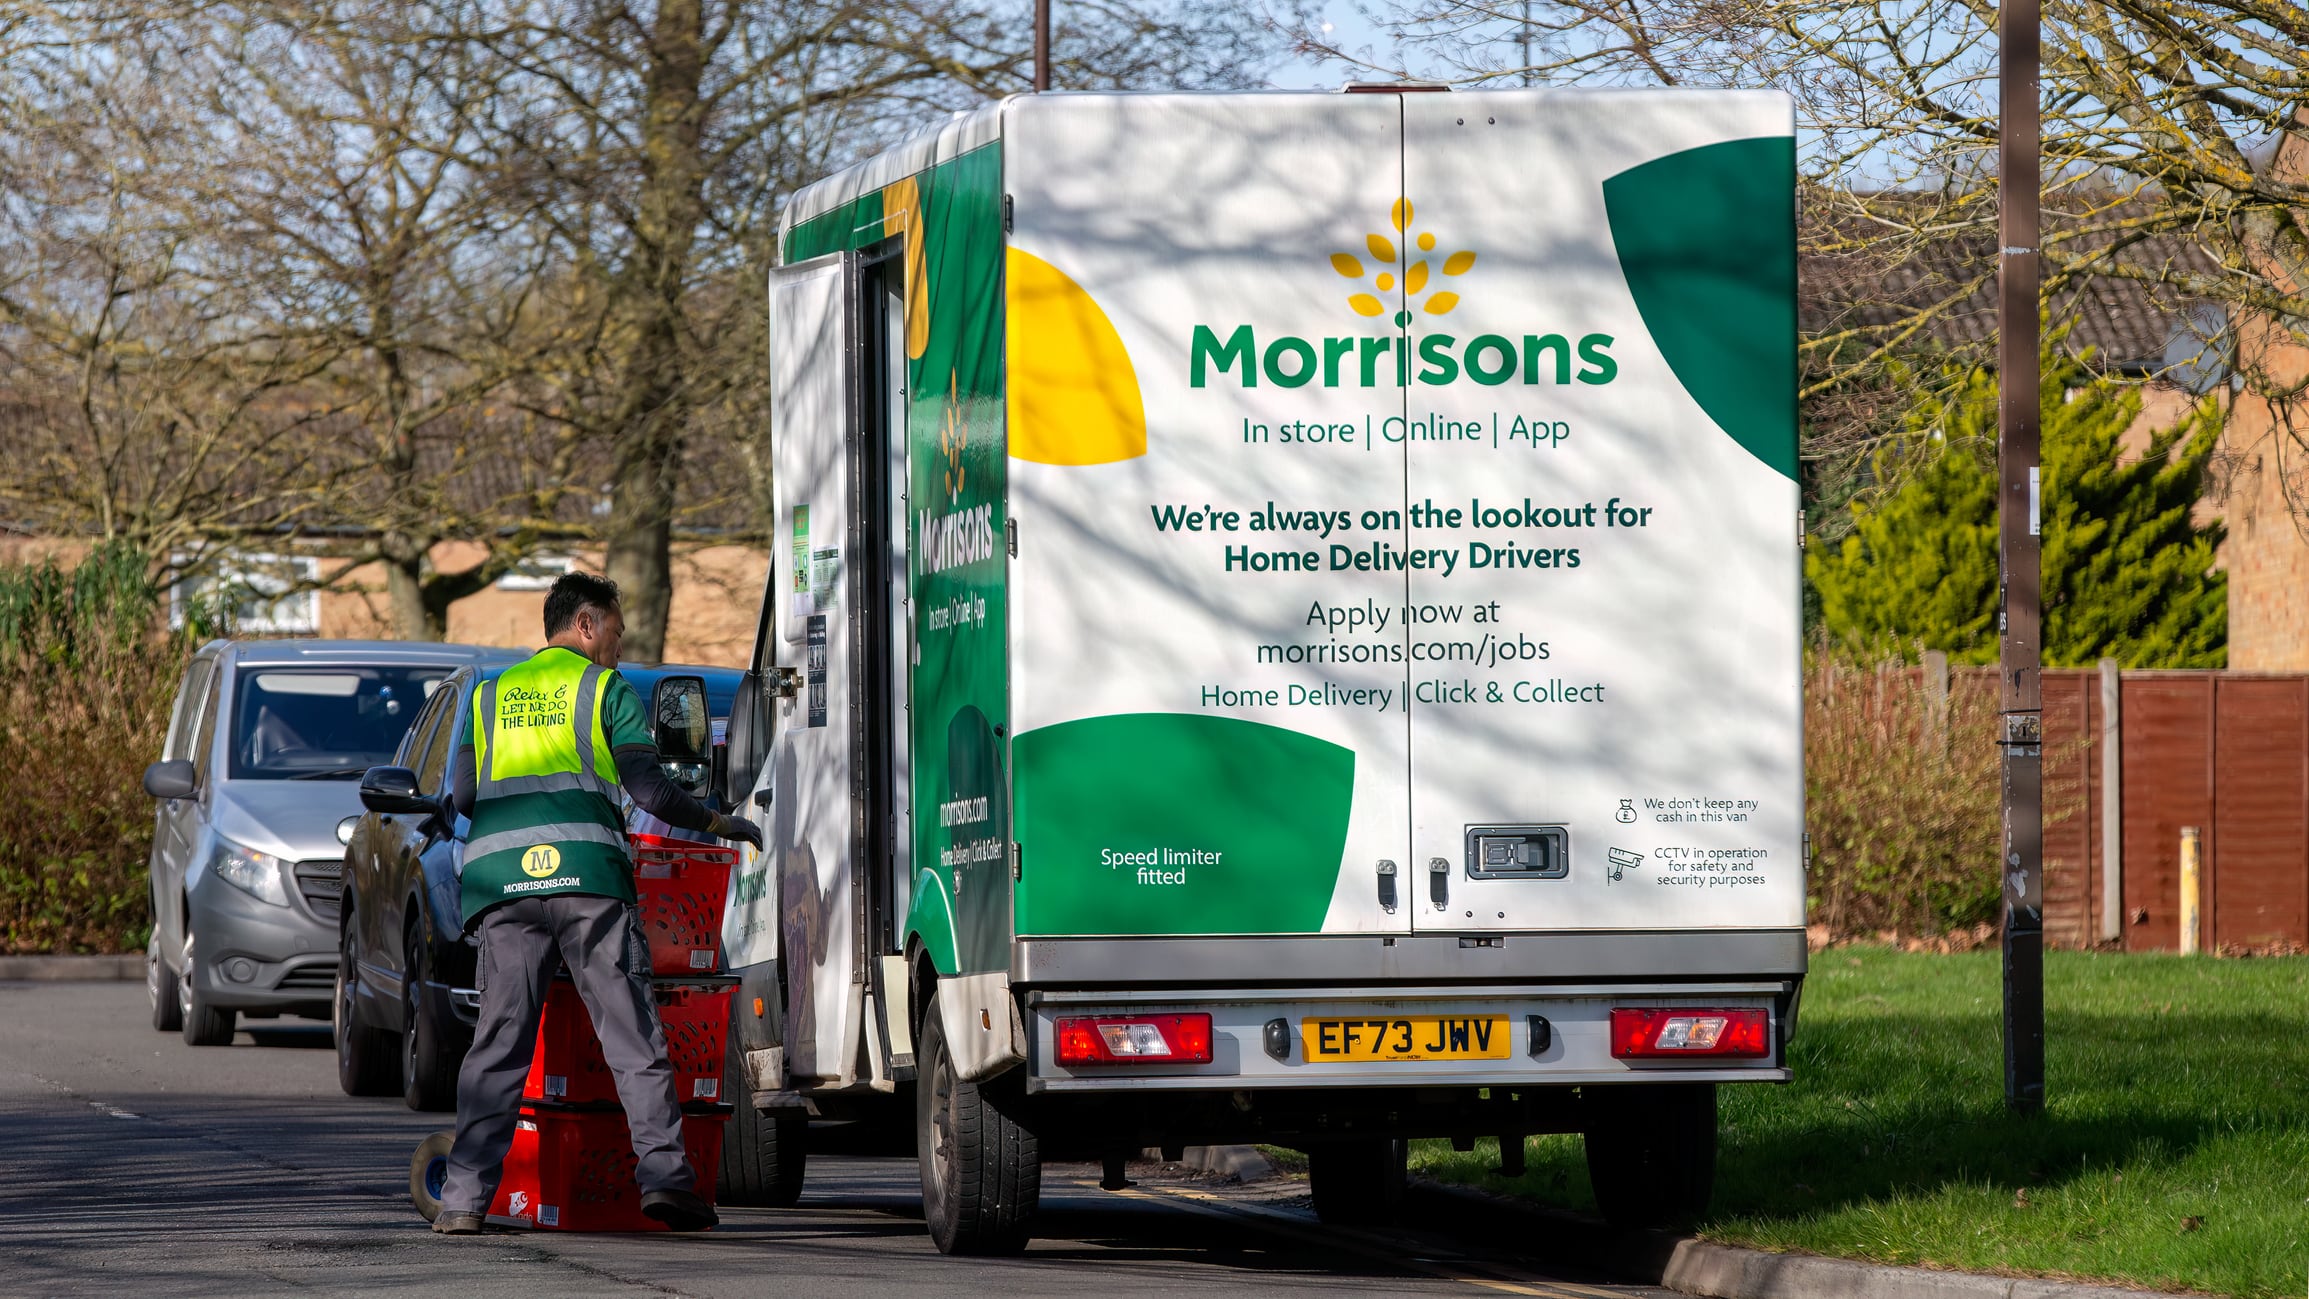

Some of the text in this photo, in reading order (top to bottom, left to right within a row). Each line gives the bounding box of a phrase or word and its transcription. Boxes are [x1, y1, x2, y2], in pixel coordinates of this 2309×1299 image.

[1190, 310, 1618, 388] Morrisons
[1243, 418, 1268, 443] In
[1280, 420, 1355, 443] store
[1382, 413, 1481, 443] Online
[1509, 415, 1570, 448] App
[919, 487, 993, 576] Morrisons
[1151, 498, 1653, 539] We're always on the lookout for
[1225, 541, 1581, 578] Home Delivery Drivers
[928, 604, 935, 631] In
[935, 604, 949, 631] store
[952, 593, 971, 627] Online
[973, 592, 985, 628] App
[1306, 599, 1500, 634] Apply now at
[1257, 633, 1550, 668] morrisons.com/jobs
[502, 703, 526, 715] LET
[548, 700, 567, 712] DO
[554, 684, 567, 699] &
[1201, 684, 1279, 708] Home
[1288, 682, 1393, 713] Delivery
[1415, 681, 1477, 705] Click
[1486, 682, 1504, 704] &
[1513, 680, 1605, 703] Collect
[501, 715, 524, 730] THE
[940, 792, 988, 828] morrisons.com
[1644, 796, 1759, 811] We don't keep any
[1656, 810, 1748, 822] cash in this van
[529, 849, 553, 871] M
[940, 846, 953, 867] Home
[953, 842, 970, 870] Delivery
[972, 838, 983, 862] Click
[987, 836, 1002, 860] Collect
[1101, 847, 1222, 870] Speed limiter
[1654, 847, 1768, 862] CCTV in operation
[1668, 859, 1754, 874] for safety and
[503, 877, 581, 894] MORRISONS.COM
[733, 861, 767, 907] Morrisons
[1136, 866, 1186, 885] fitted
[1657, 873, 1766, 888] security purposes
[1319, 1019, 1493, 1054] EF73 JWV
